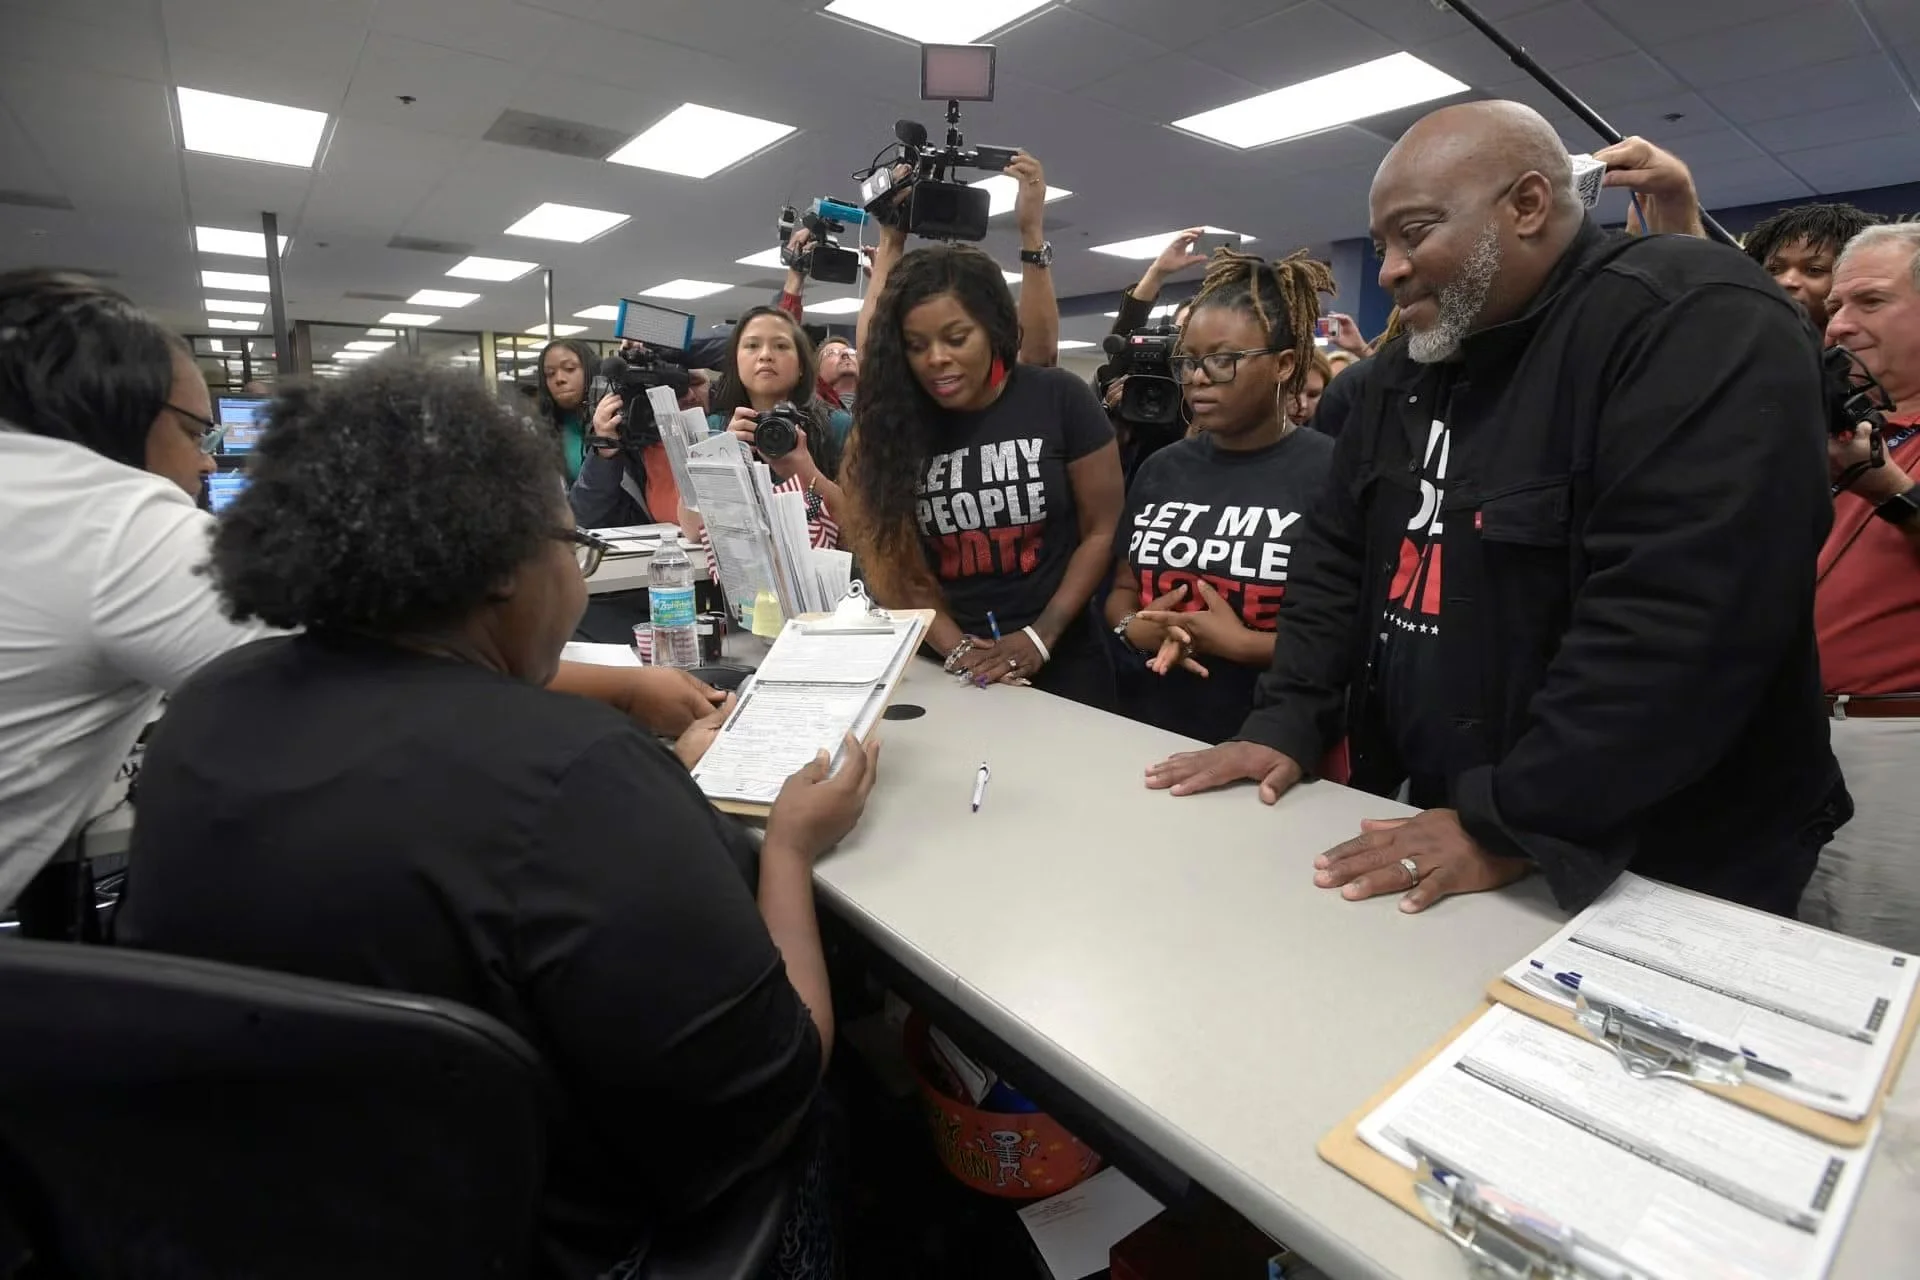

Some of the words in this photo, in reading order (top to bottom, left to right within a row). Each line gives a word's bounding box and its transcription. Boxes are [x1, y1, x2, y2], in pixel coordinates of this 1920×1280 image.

[980, 438, 1043, 483] MY
[916, 482, 1047, 536] PEOPLE
[1134, 502, 1210, 532] LET
[1215, 506, 1301, 538] MY
[1129, 530, 1291, 580] PEOPLE
